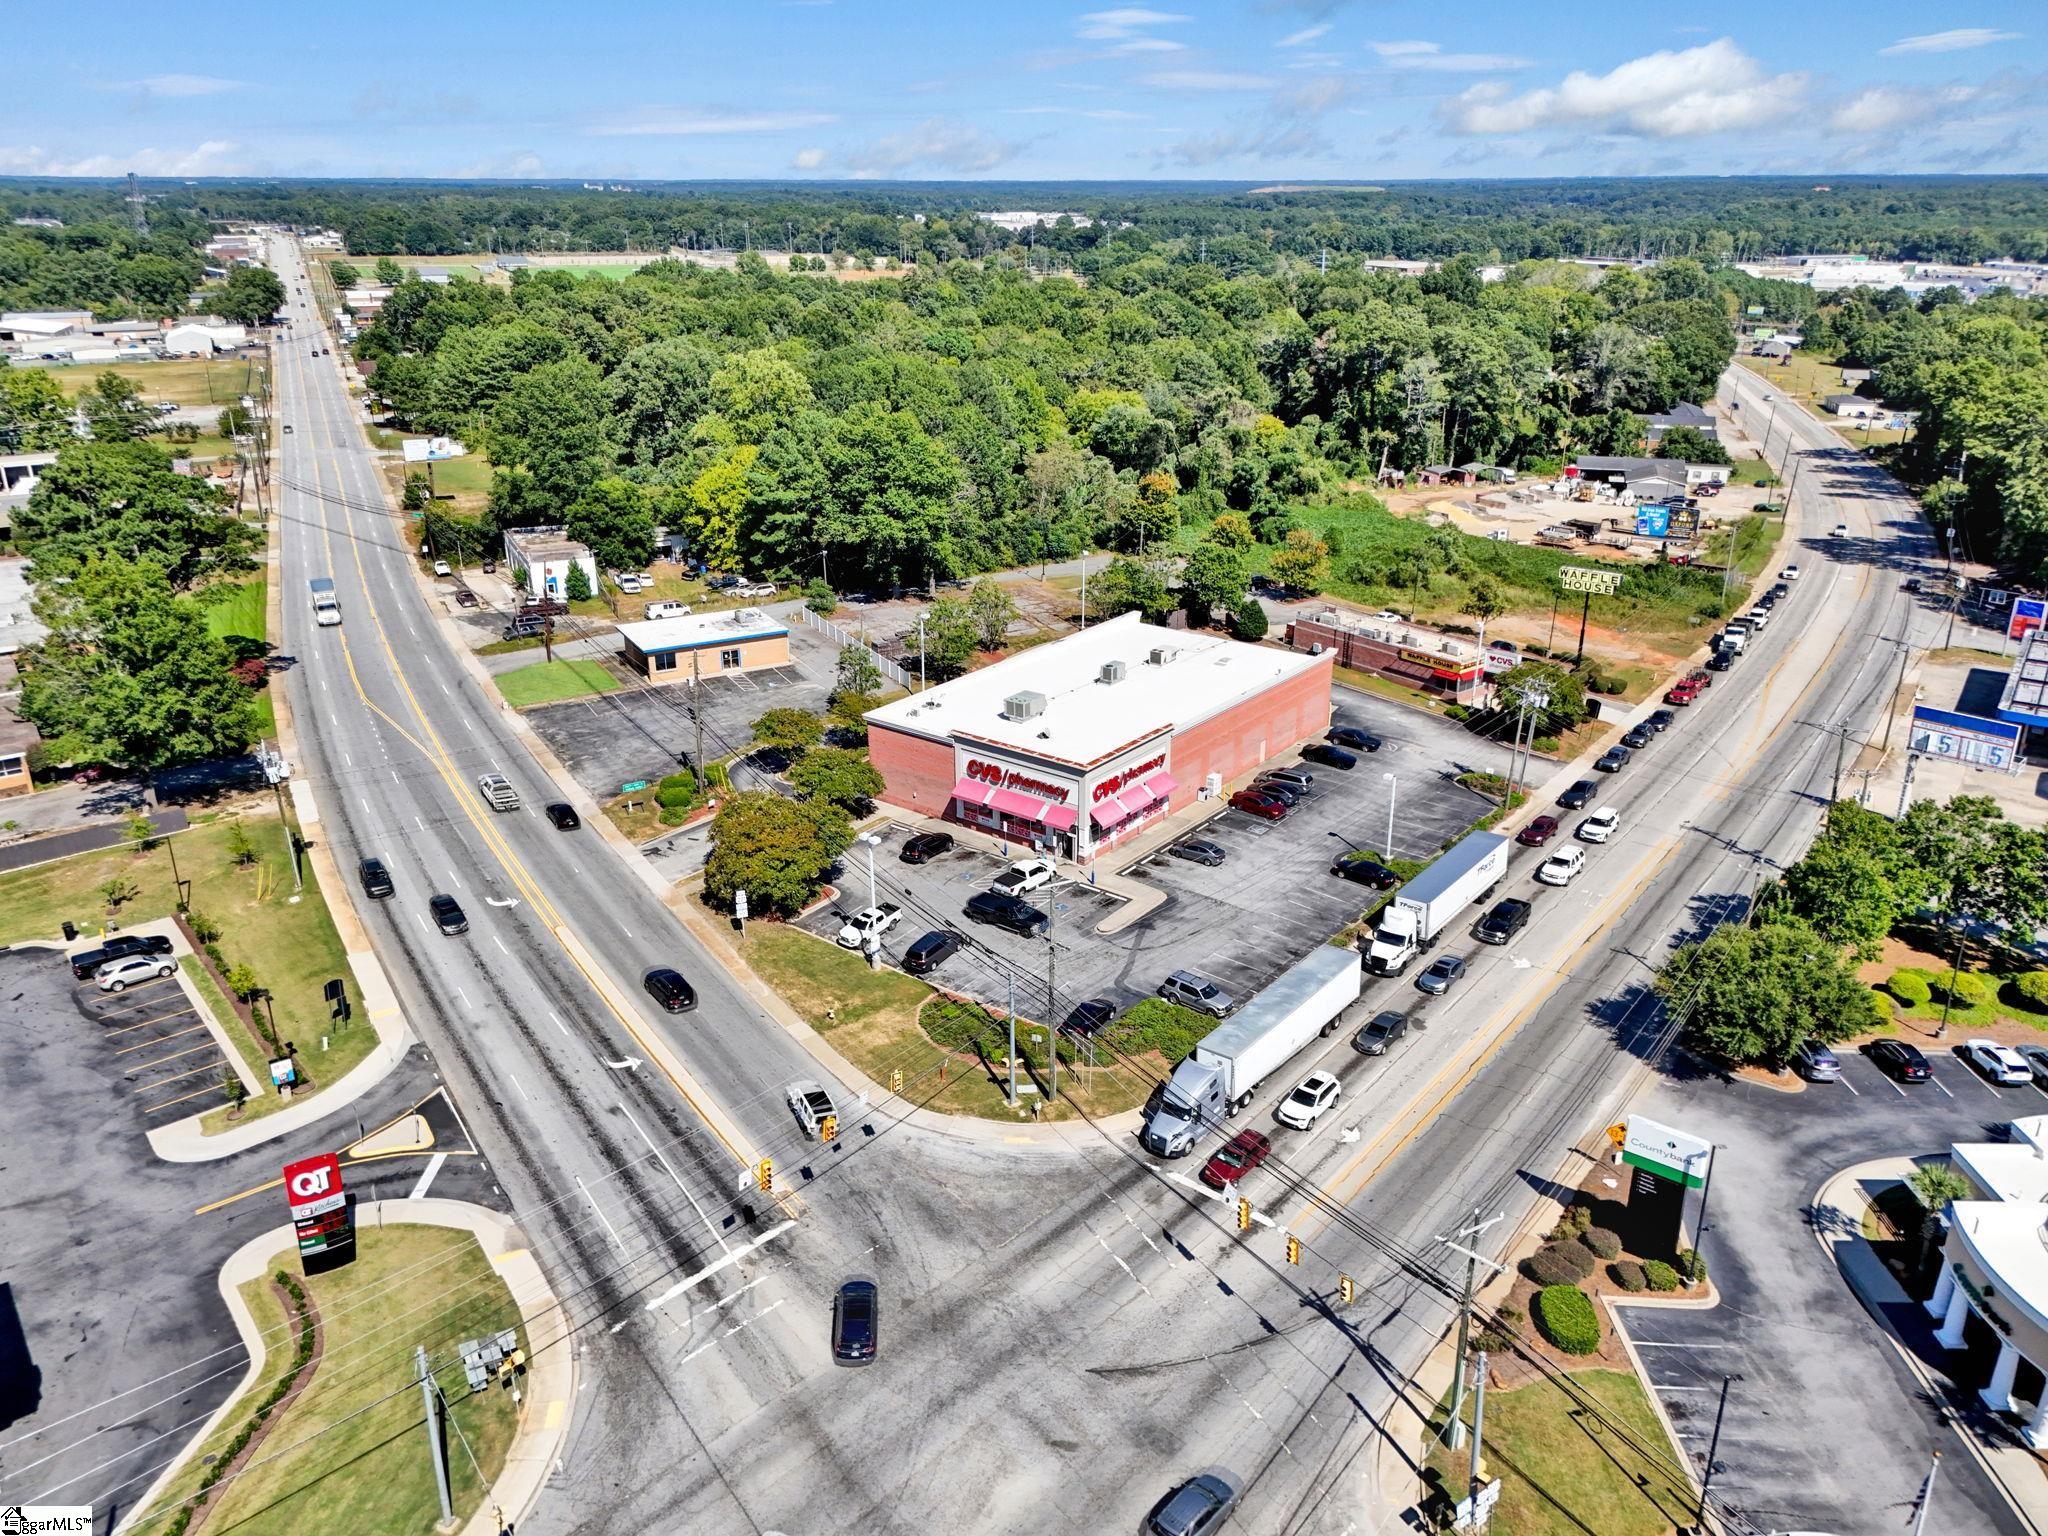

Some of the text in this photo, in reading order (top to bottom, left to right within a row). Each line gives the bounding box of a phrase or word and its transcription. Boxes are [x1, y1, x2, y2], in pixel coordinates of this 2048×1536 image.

[1560, 569, 1619, 585] WAFFLE
[1563, 579, 1612, 594] HOUSE
[1496, 656, 1513, 665] CVS
[1938, 735, 1952, 753] 5
[1989, 746, 2004, 765] 5
[1399, 901, 1423, 912] TForce
[1630, 1137, 1696, 1168] Countybank
[291, 1165, 332, 1197] QT
